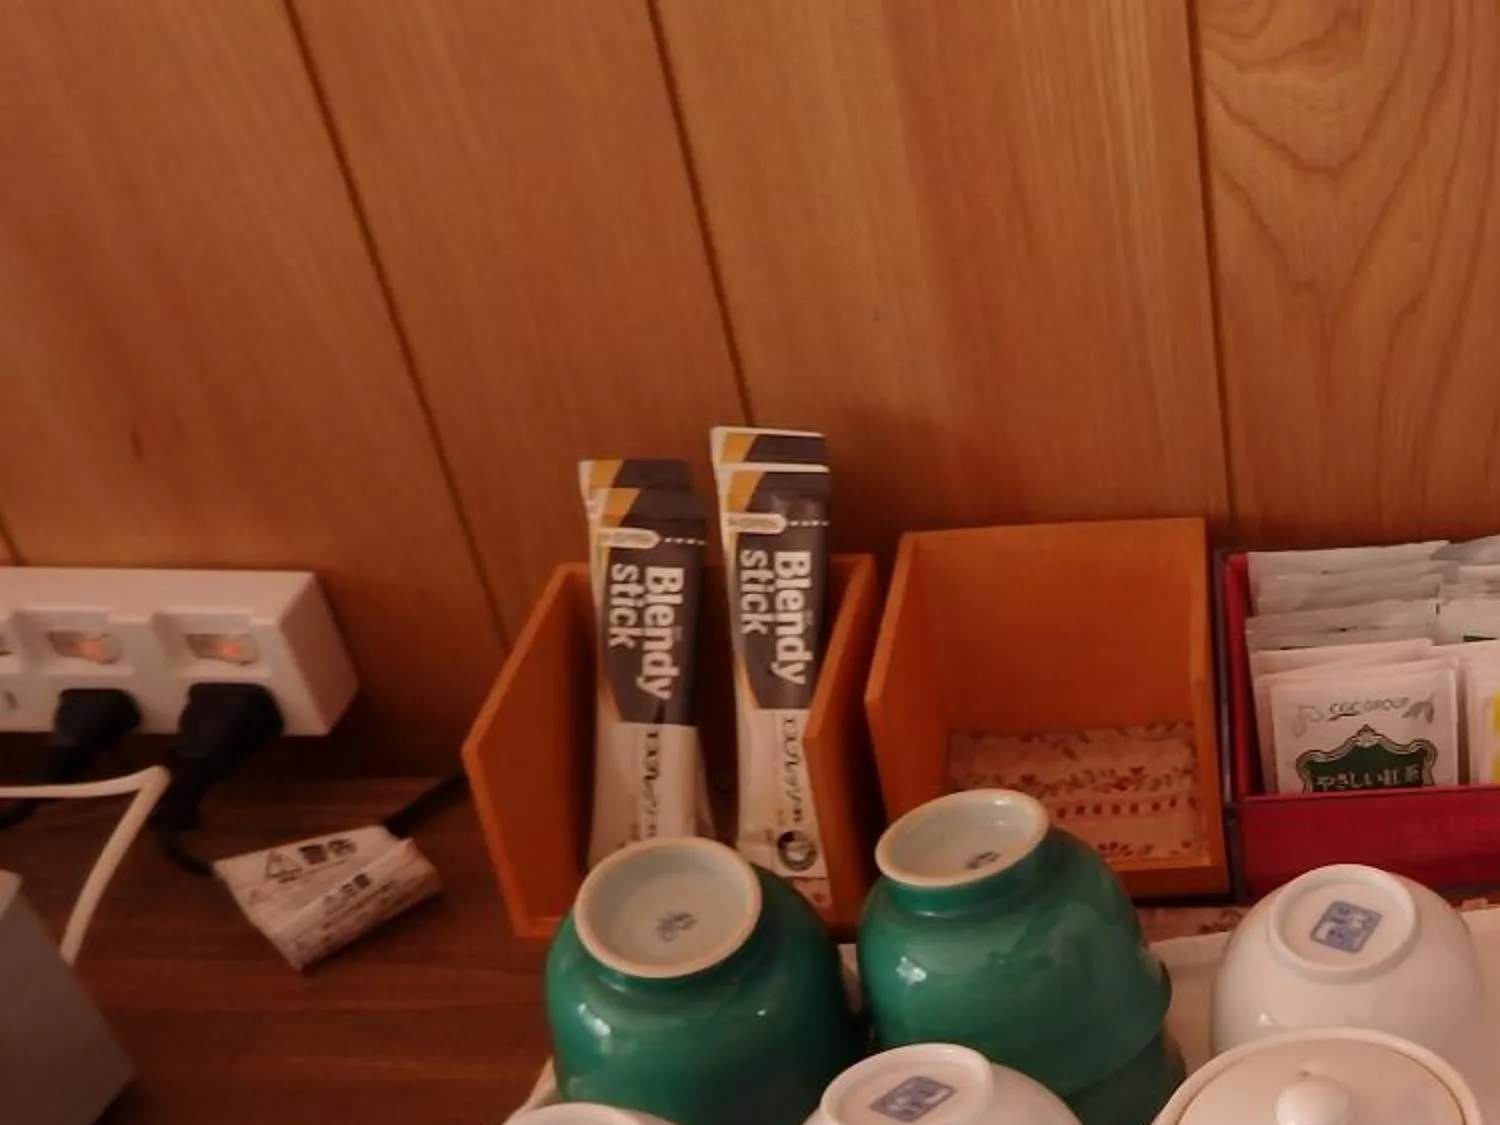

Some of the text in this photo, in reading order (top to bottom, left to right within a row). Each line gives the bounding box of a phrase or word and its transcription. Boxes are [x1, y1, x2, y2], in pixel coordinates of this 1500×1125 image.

[608, 563, 645, 648] stick
[636, 566, 684, 699] Blendy
[740, 549, 775, 635] stick
[770, 551, 813, 684] Blendy
